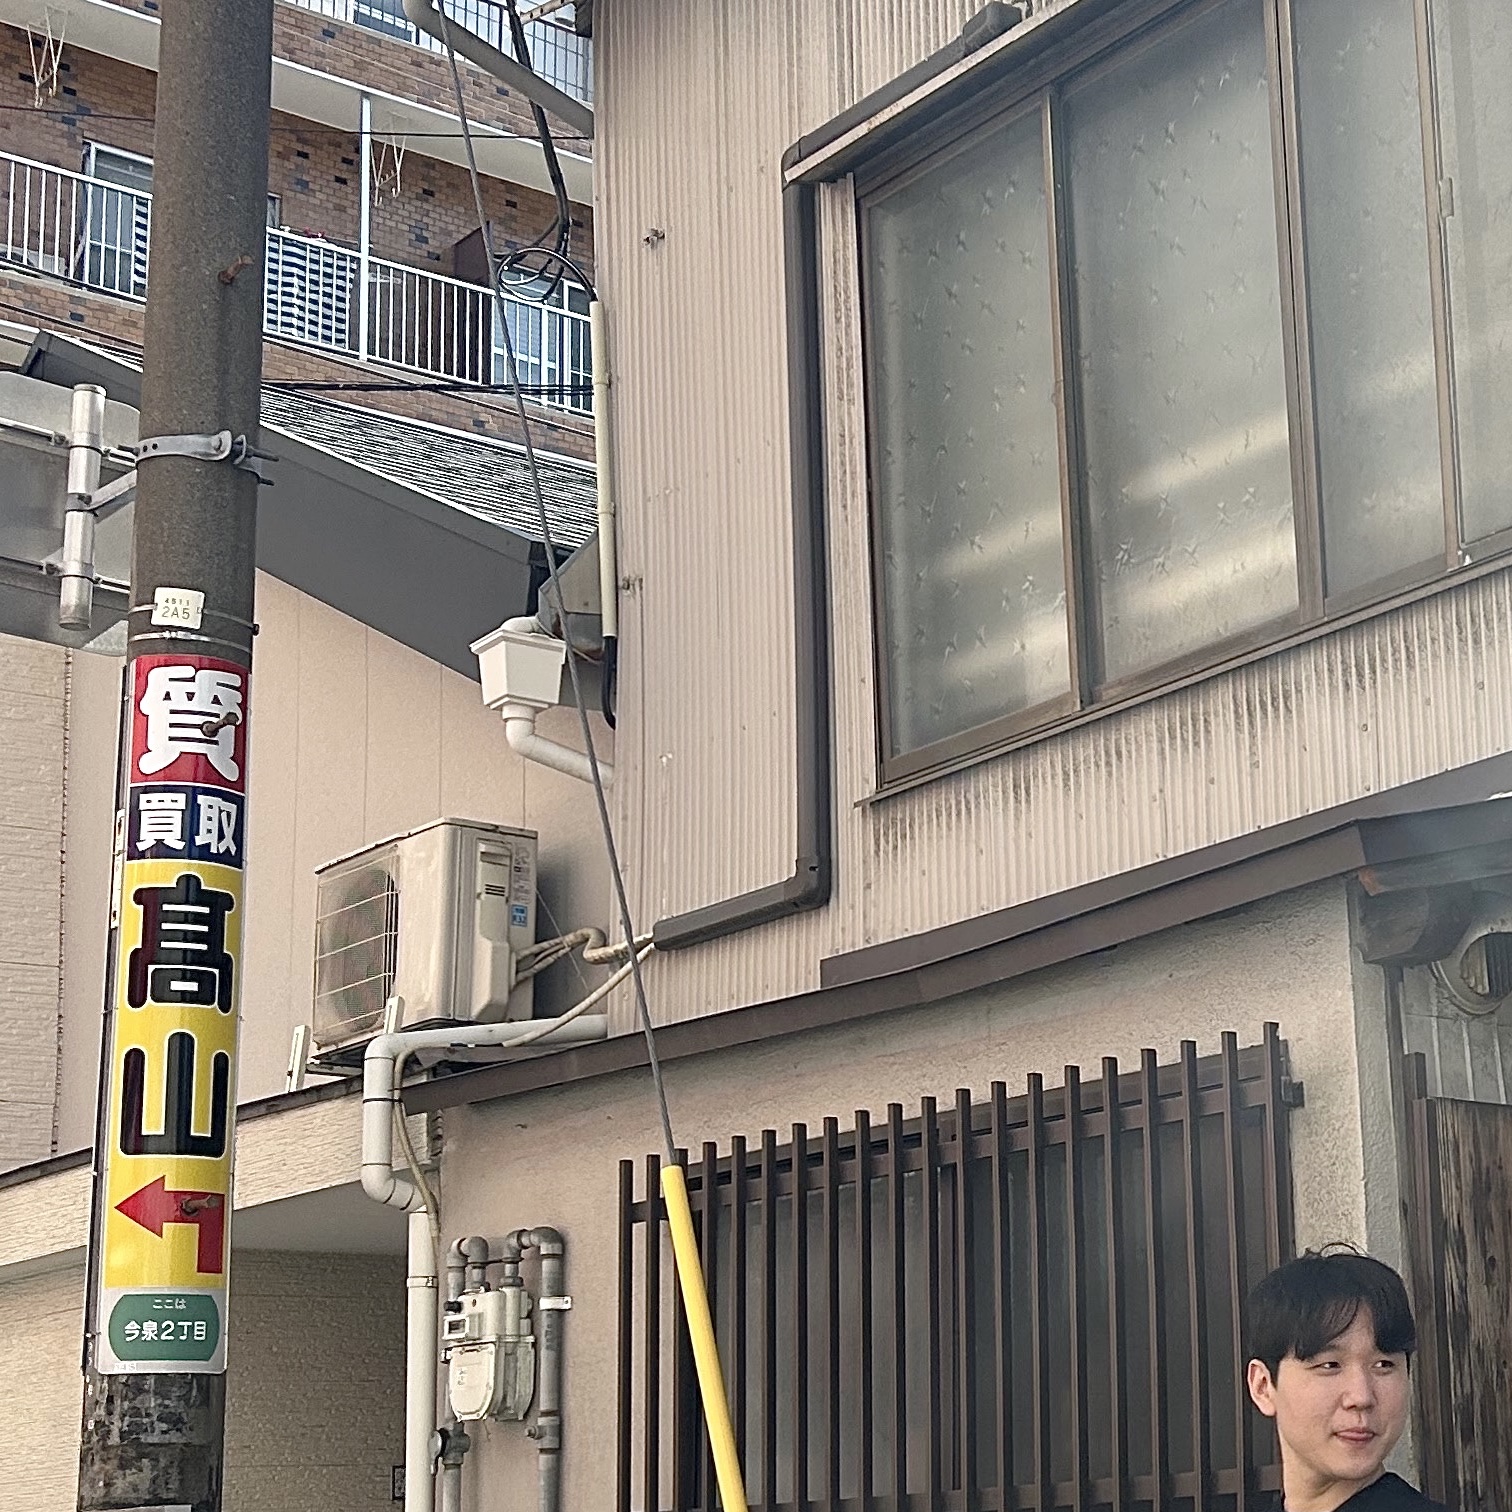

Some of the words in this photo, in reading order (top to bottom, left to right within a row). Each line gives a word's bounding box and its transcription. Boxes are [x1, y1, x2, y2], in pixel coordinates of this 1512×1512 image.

[162, 606, 190, 620] 2A5
[138, 666, 243, 782] 質
[136, 793, 238, 856] 買取
[153, 1298, 186, 1310] ここは
[124, 1320, 207, 1341] 今泉2丁目
